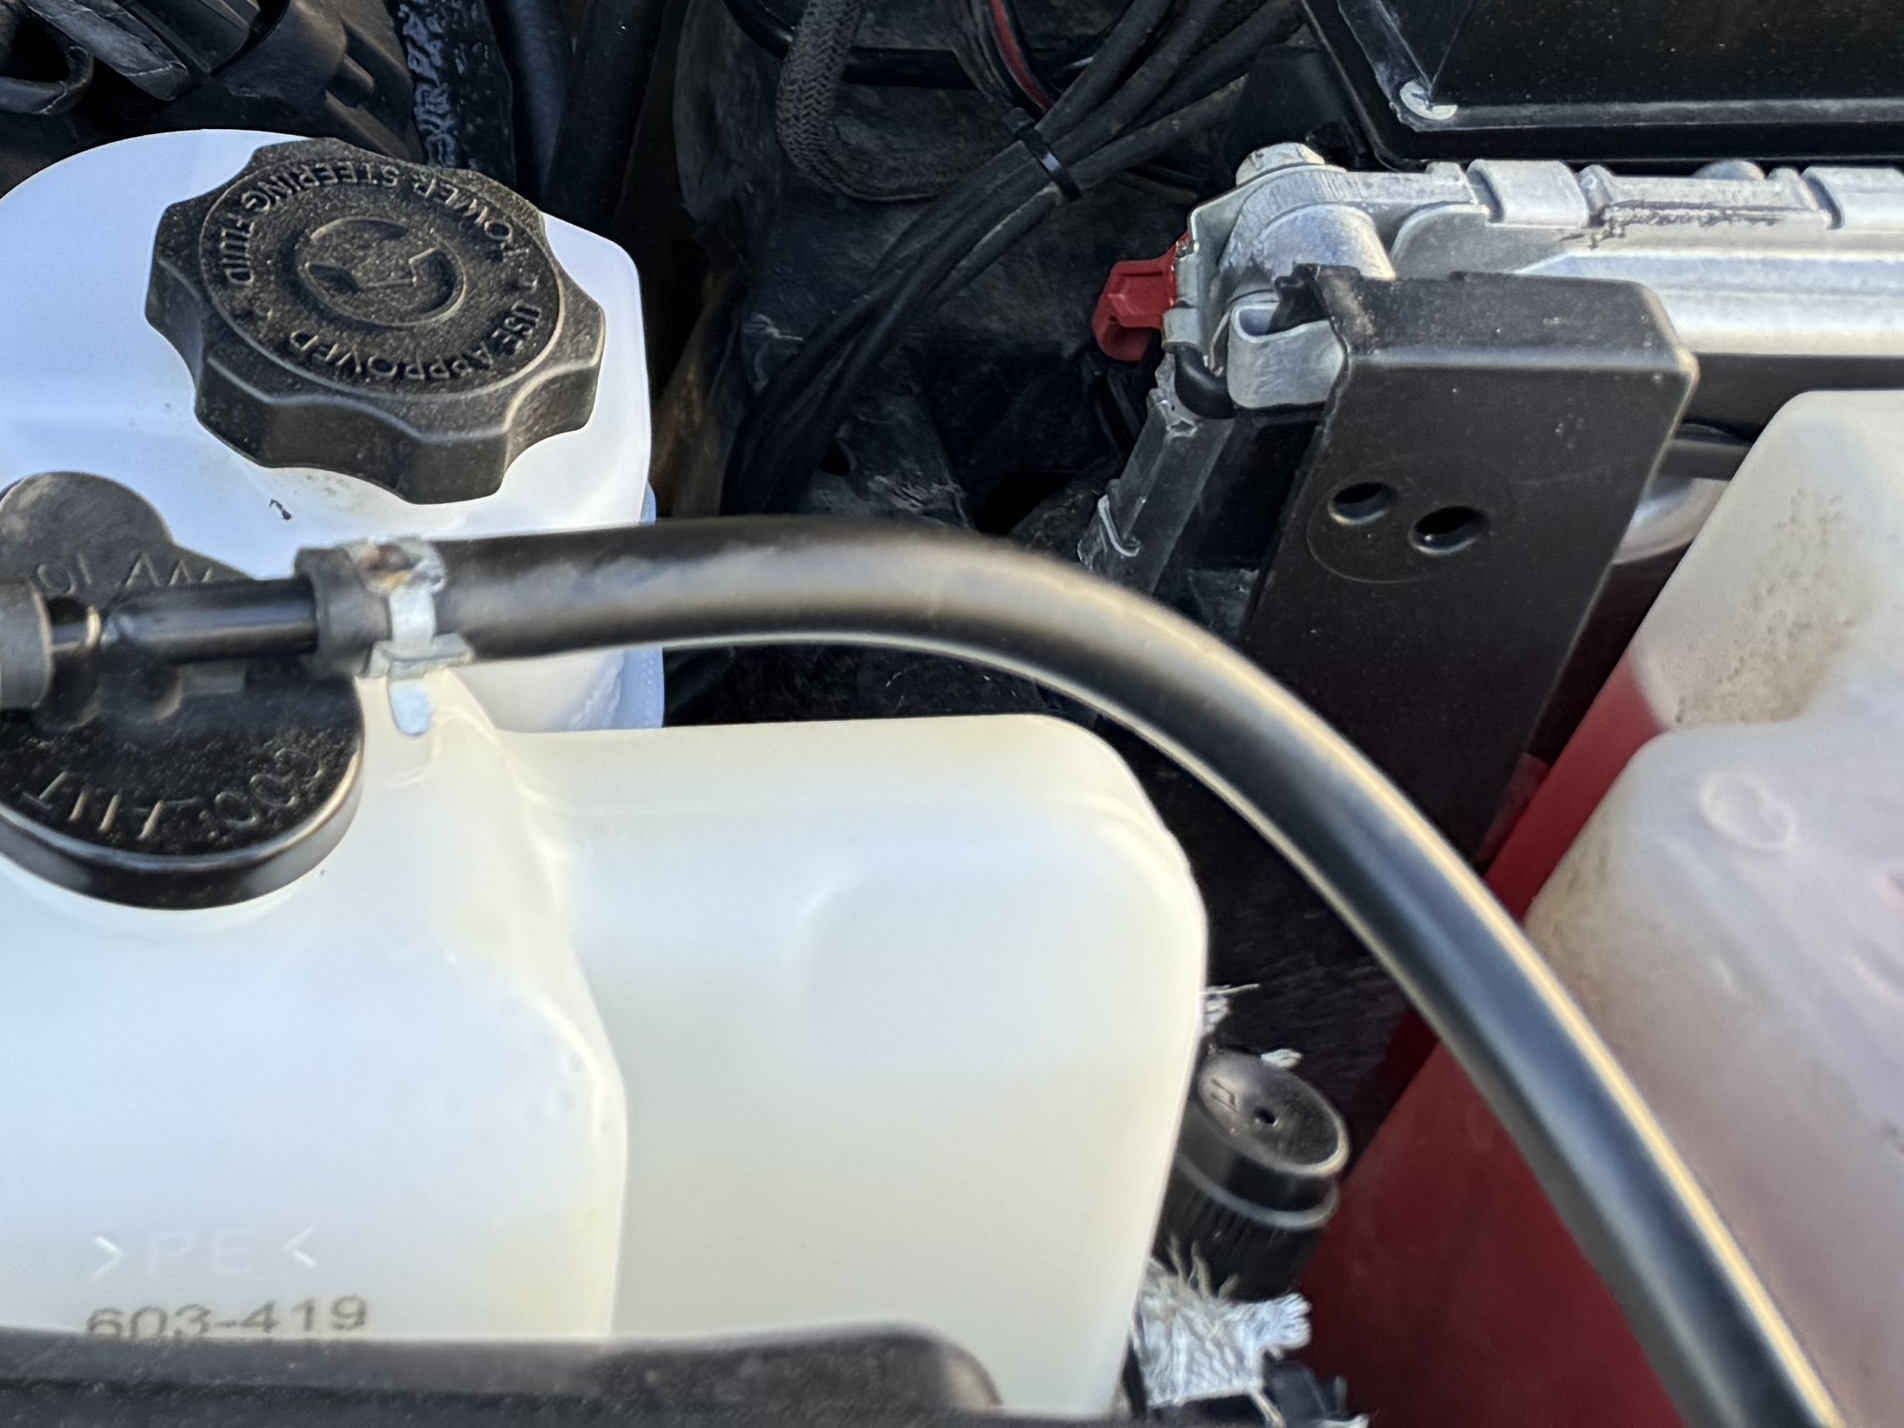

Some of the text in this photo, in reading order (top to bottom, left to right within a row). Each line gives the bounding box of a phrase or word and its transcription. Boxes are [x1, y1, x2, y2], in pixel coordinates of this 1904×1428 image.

[241, 162, 400, 213] STEERING
[220, 210, 256, 285] FLUID
[289, 299, 542, 381] USE APPROVED
[86, 1294, 369, 1339] 603-419
